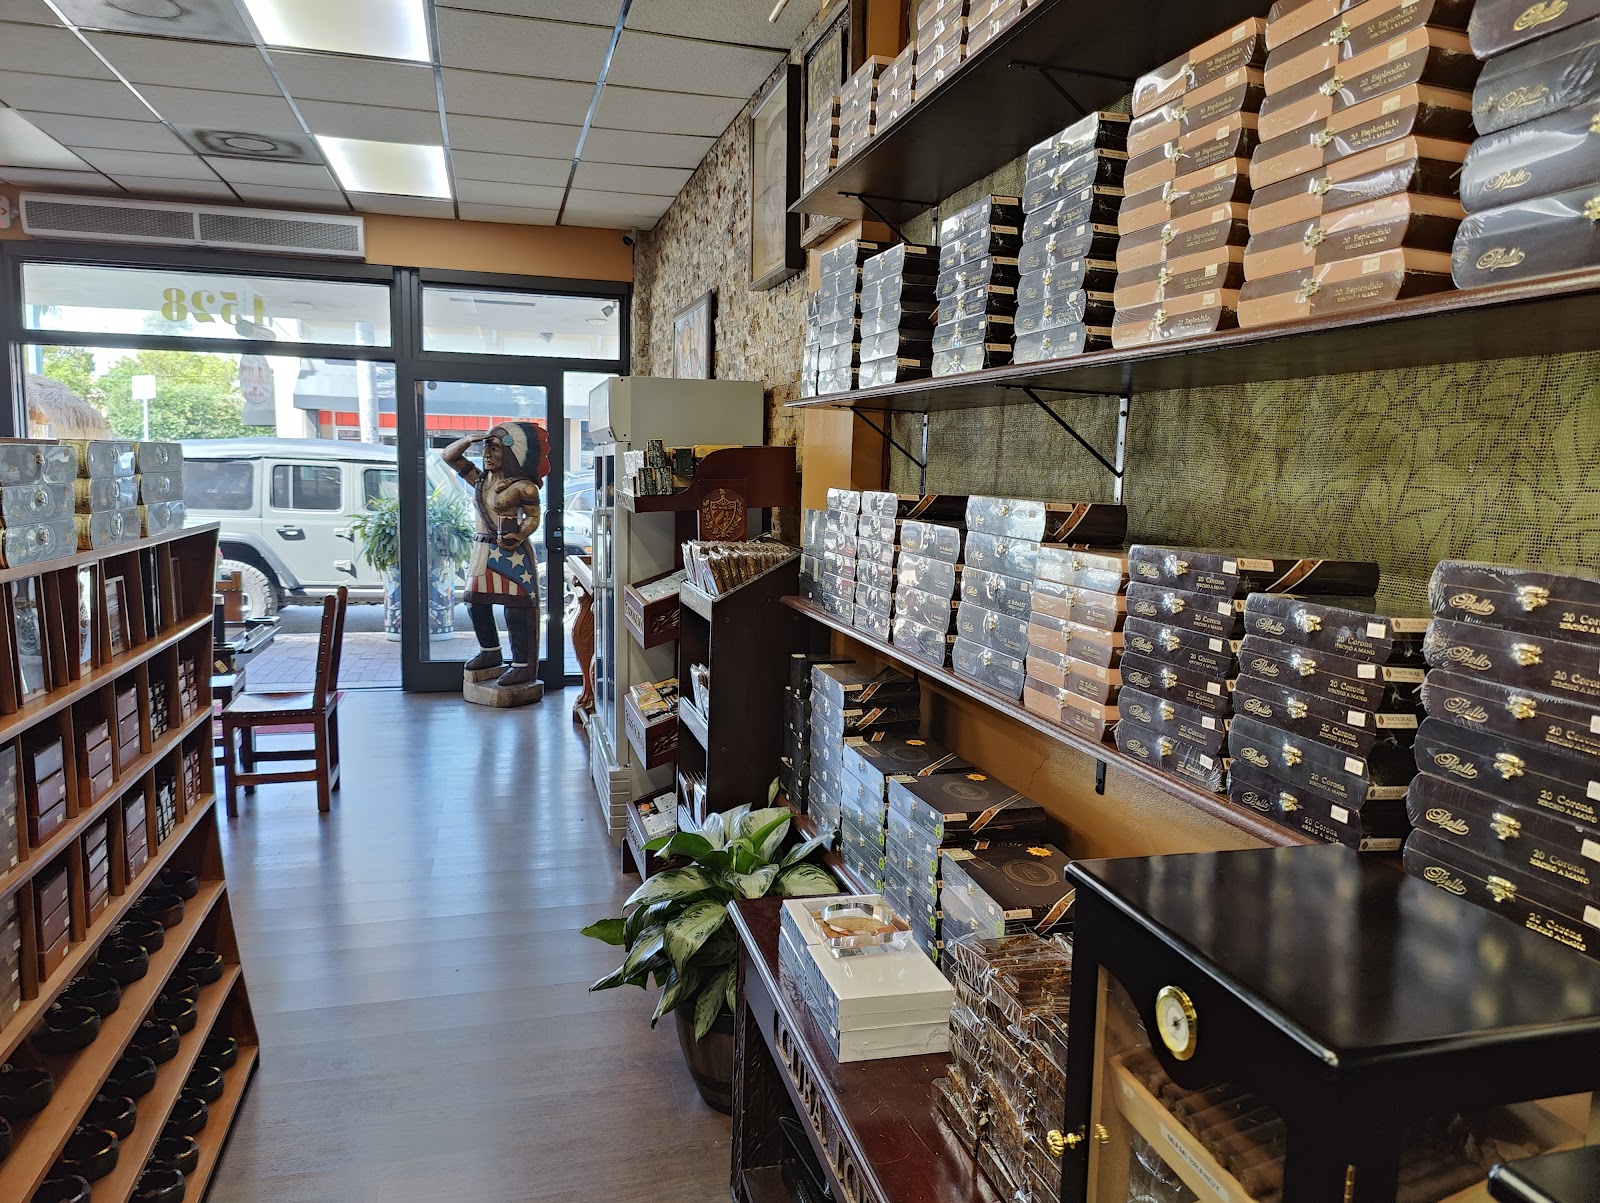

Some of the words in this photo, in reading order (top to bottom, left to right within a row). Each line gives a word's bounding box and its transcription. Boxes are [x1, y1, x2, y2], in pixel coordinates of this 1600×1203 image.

[1360, 78, 1368, 87] 20
[1137, 562, 1159, 579] Bello
[1206, 577, 1224, 585] Corona
[1135, 601, 1157, 616] Bello
[1449, 592, 1496, 616] Bello
[1203, 616, 1221, 625] Corona
[1562, 612, 1575, 622] 20
[1256, 617, 1285, 635] Bello
[1132, 637, 1154, 653] Bello
[1336, 636, 1345, 644] 20
[1348, 638, 1373, 648] Corona
[1198, 655, 1217, 665] Corona
[1448, 646, 1492, 671] Bello
[1251, 658, 1279, 677] Bello
[1554, 670, 1567, 681] 20
[1129, 672, 1150, 688] Bello
[1330, 680, 1338, 688] 20
[1340, 682, 1365, 694] Corona
[1129, 705, 1152, 722] Bello
[1244, 699, 1272, 718] Bello
[1444, 697, 1488, 723] Bello
[1321, 724, 1330, 732] 20
[1332, 727, 1356, 741] Corona
[1548, 725, 1562, 736] 20
[1241, 747, 1269, 768] Bello
[1434, 753, 1478, 779] Bello
[1310, 772, 1319, 780] 20
[1321, 776, 1345, 790] Corona
[1242, 791, 1270, 812] Bello
[1540, 790, 1553, 800] 20
[1557, 795, 1594, 815] Corona
[1304, 816, 1313, 825] 20
[1314, 821, 1338, 837] Corona
[1426, 808, 1469, 835] Bello
[1532, 850, 1546, 860] 20
[1551, 856, 1586, 875] Corona
[1424, 867, 1467, 895] Bello
